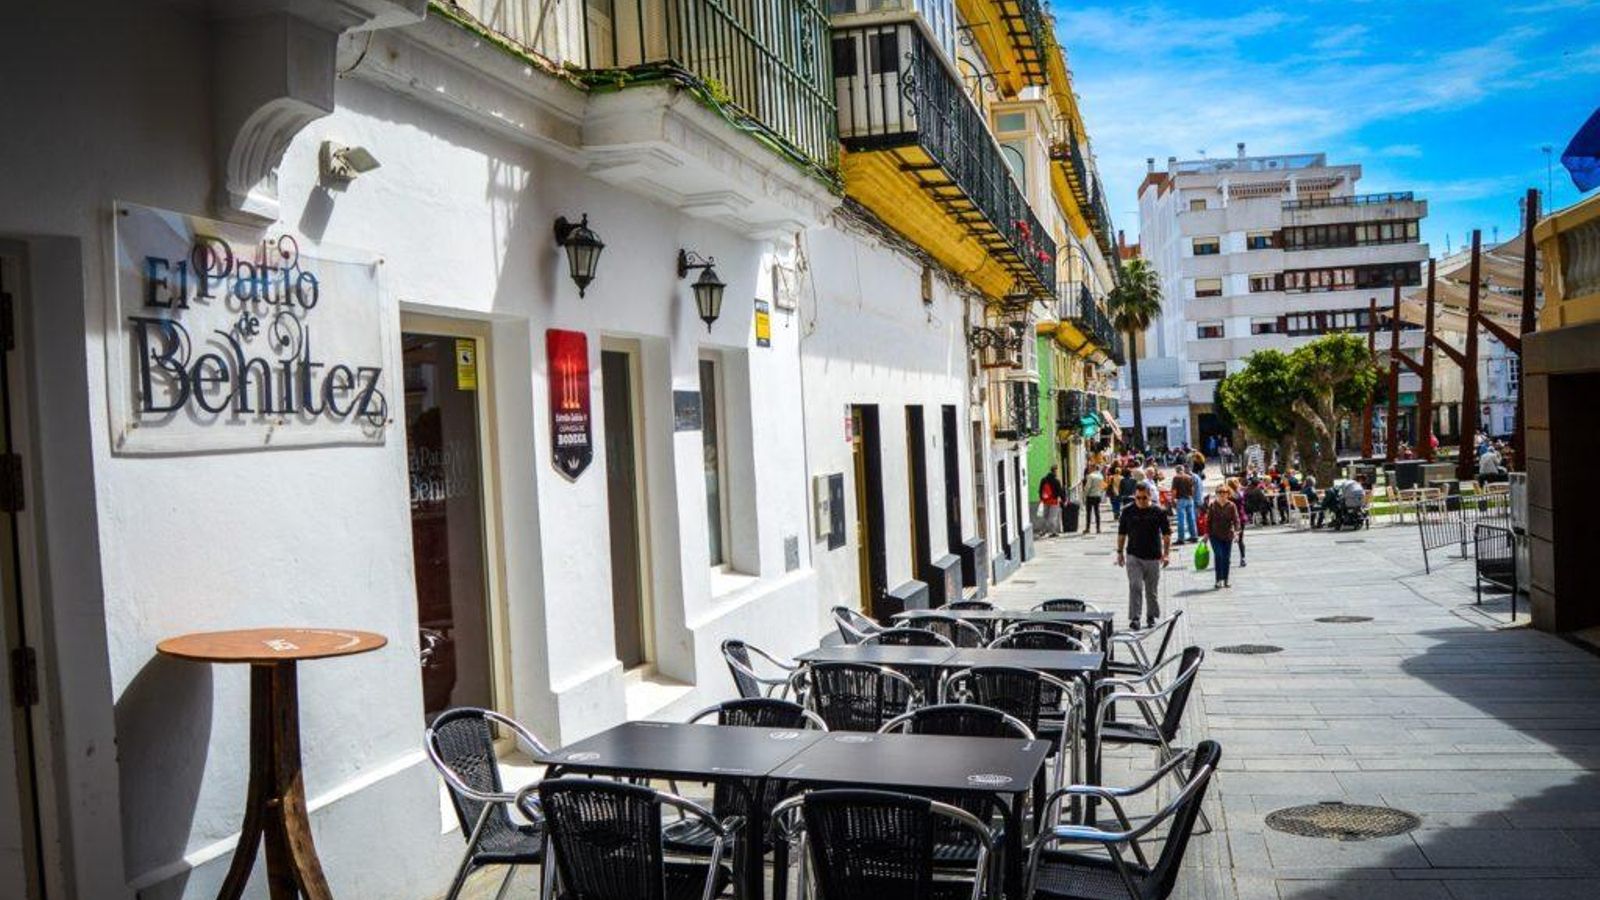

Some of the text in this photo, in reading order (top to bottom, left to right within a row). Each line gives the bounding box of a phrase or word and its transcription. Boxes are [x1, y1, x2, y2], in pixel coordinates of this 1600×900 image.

[145, 234, 319, 310] El Patio
[237, 311, 260, 336] de
